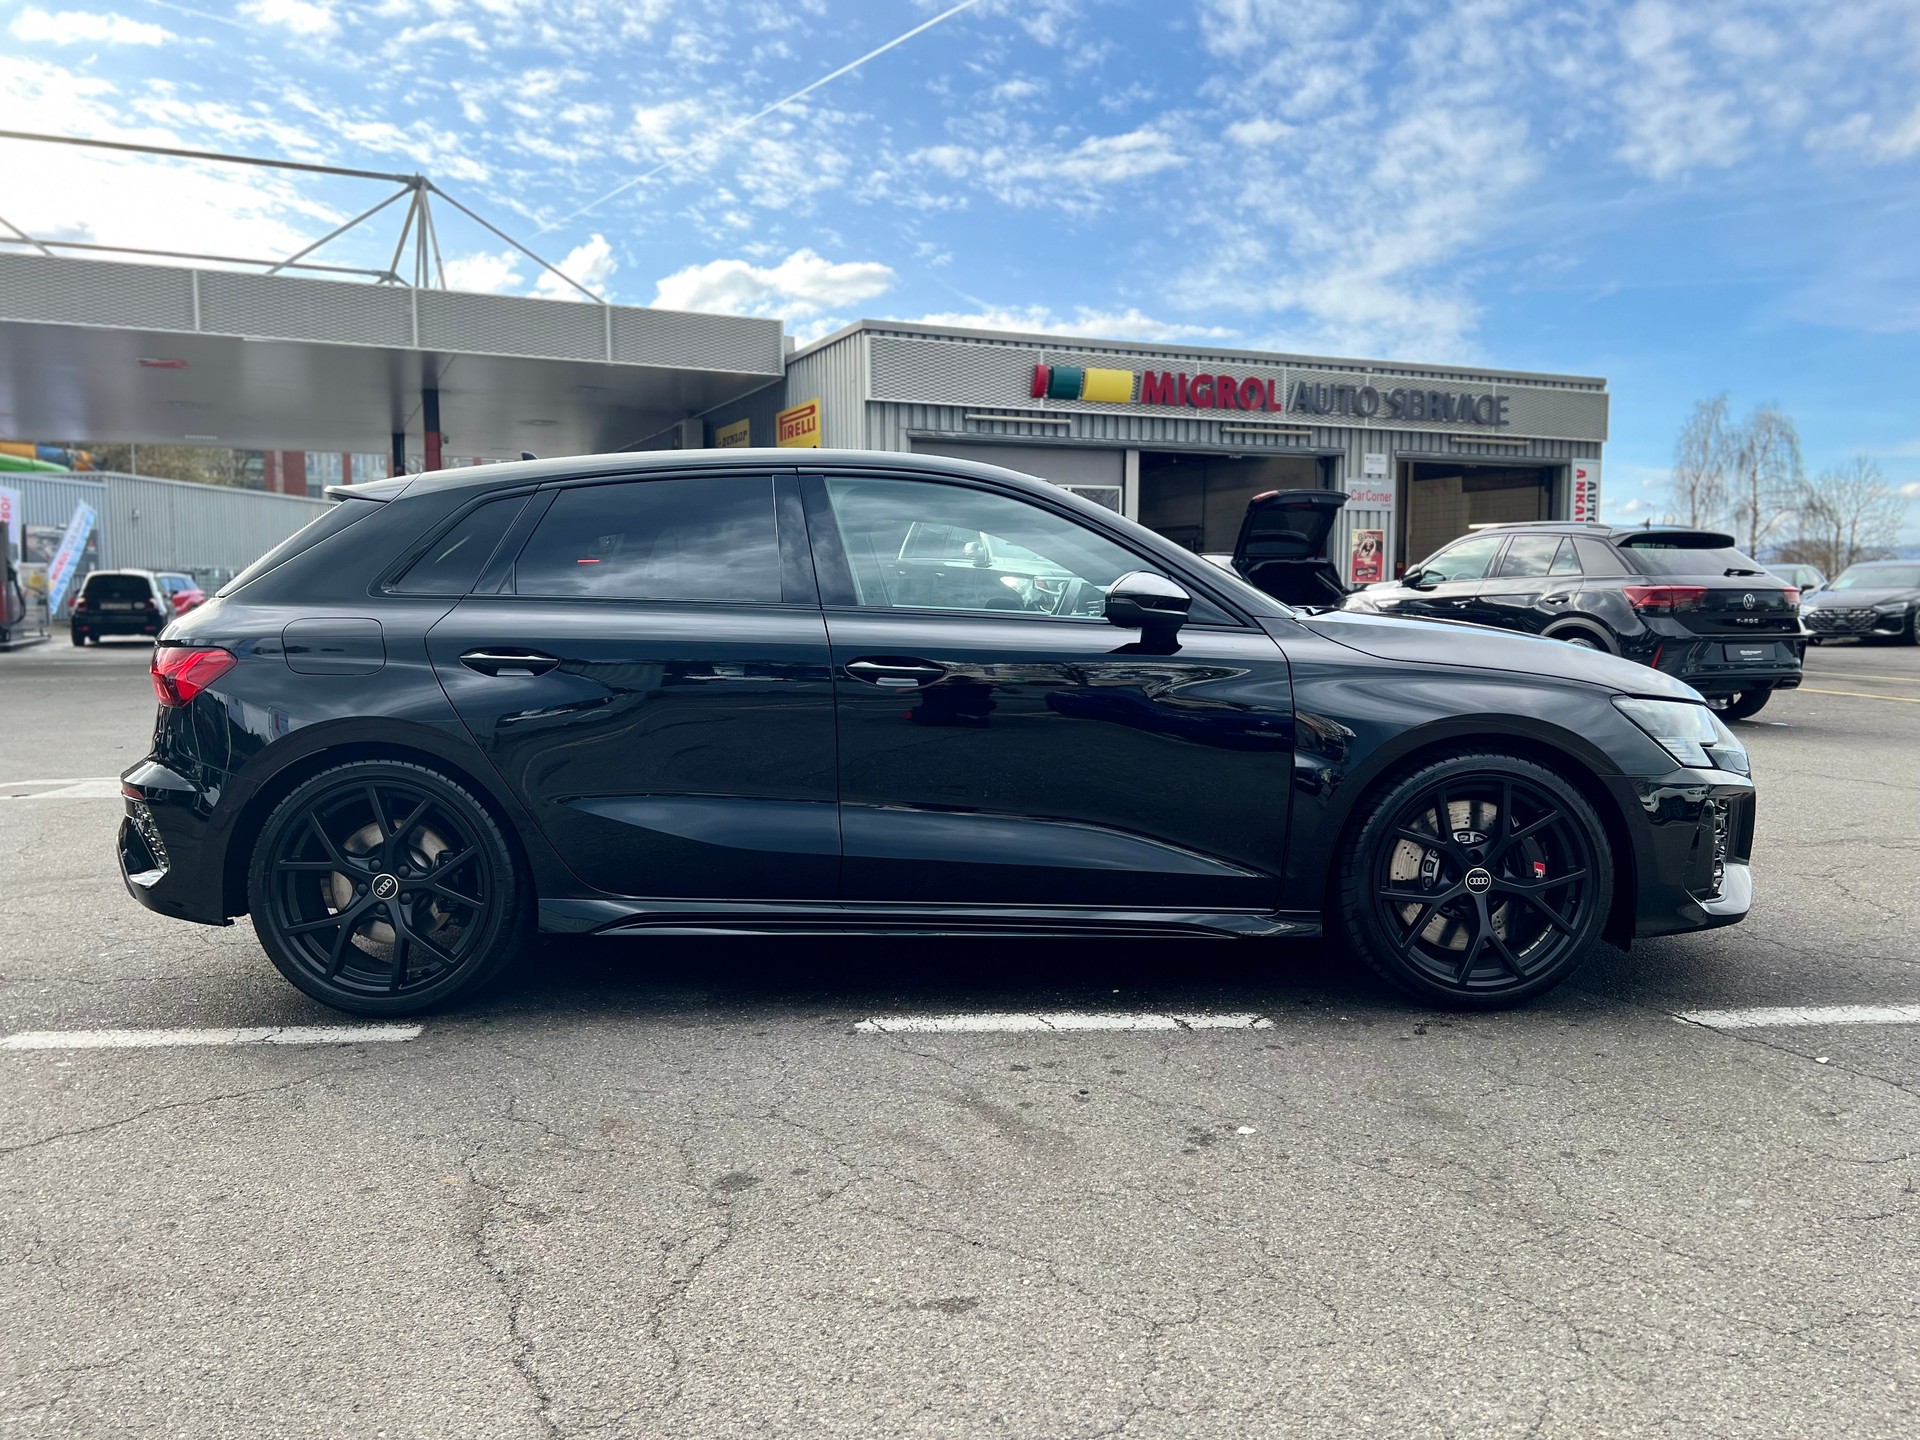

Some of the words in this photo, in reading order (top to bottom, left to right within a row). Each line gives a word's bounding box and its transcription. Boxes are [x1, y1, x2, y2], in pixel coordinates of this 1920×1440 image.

[1140, 370, 1282, 412] MIGROL
[1286, 380, 1379, 418] AUTO
[1387, 387, 1510, 426] SERVICE
[722, 430, 748, 447] DUNLOP
[779, 404, 816, 442] PIRELLI
